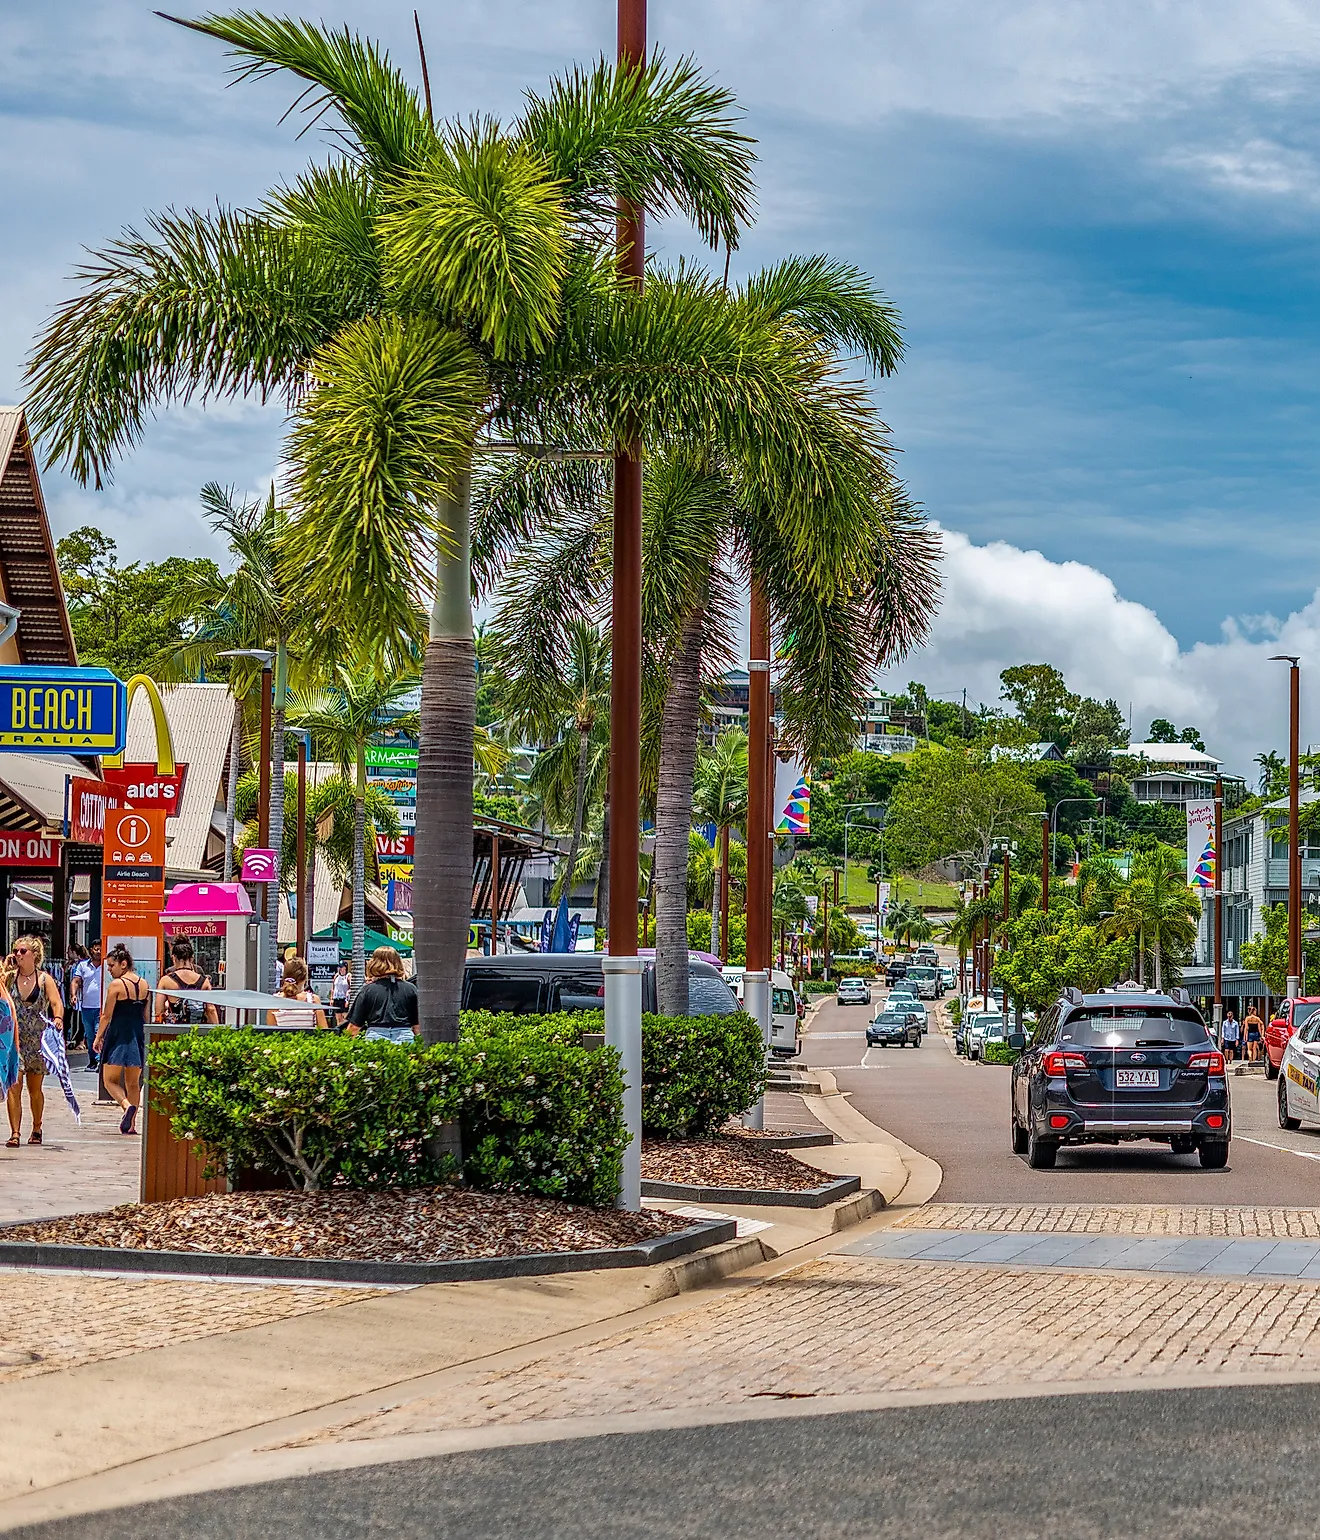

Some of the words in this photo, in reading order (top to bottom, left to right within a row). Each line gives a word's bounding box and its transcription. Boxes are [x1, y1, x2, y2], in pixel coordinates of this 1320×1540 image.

[11, 687, 93, 731] BEACH
[380, 868, 396, 881] ski
[171, 926, 202, 934] TELSTRA
[1302, 1075, 1315, 1094] TAXI
